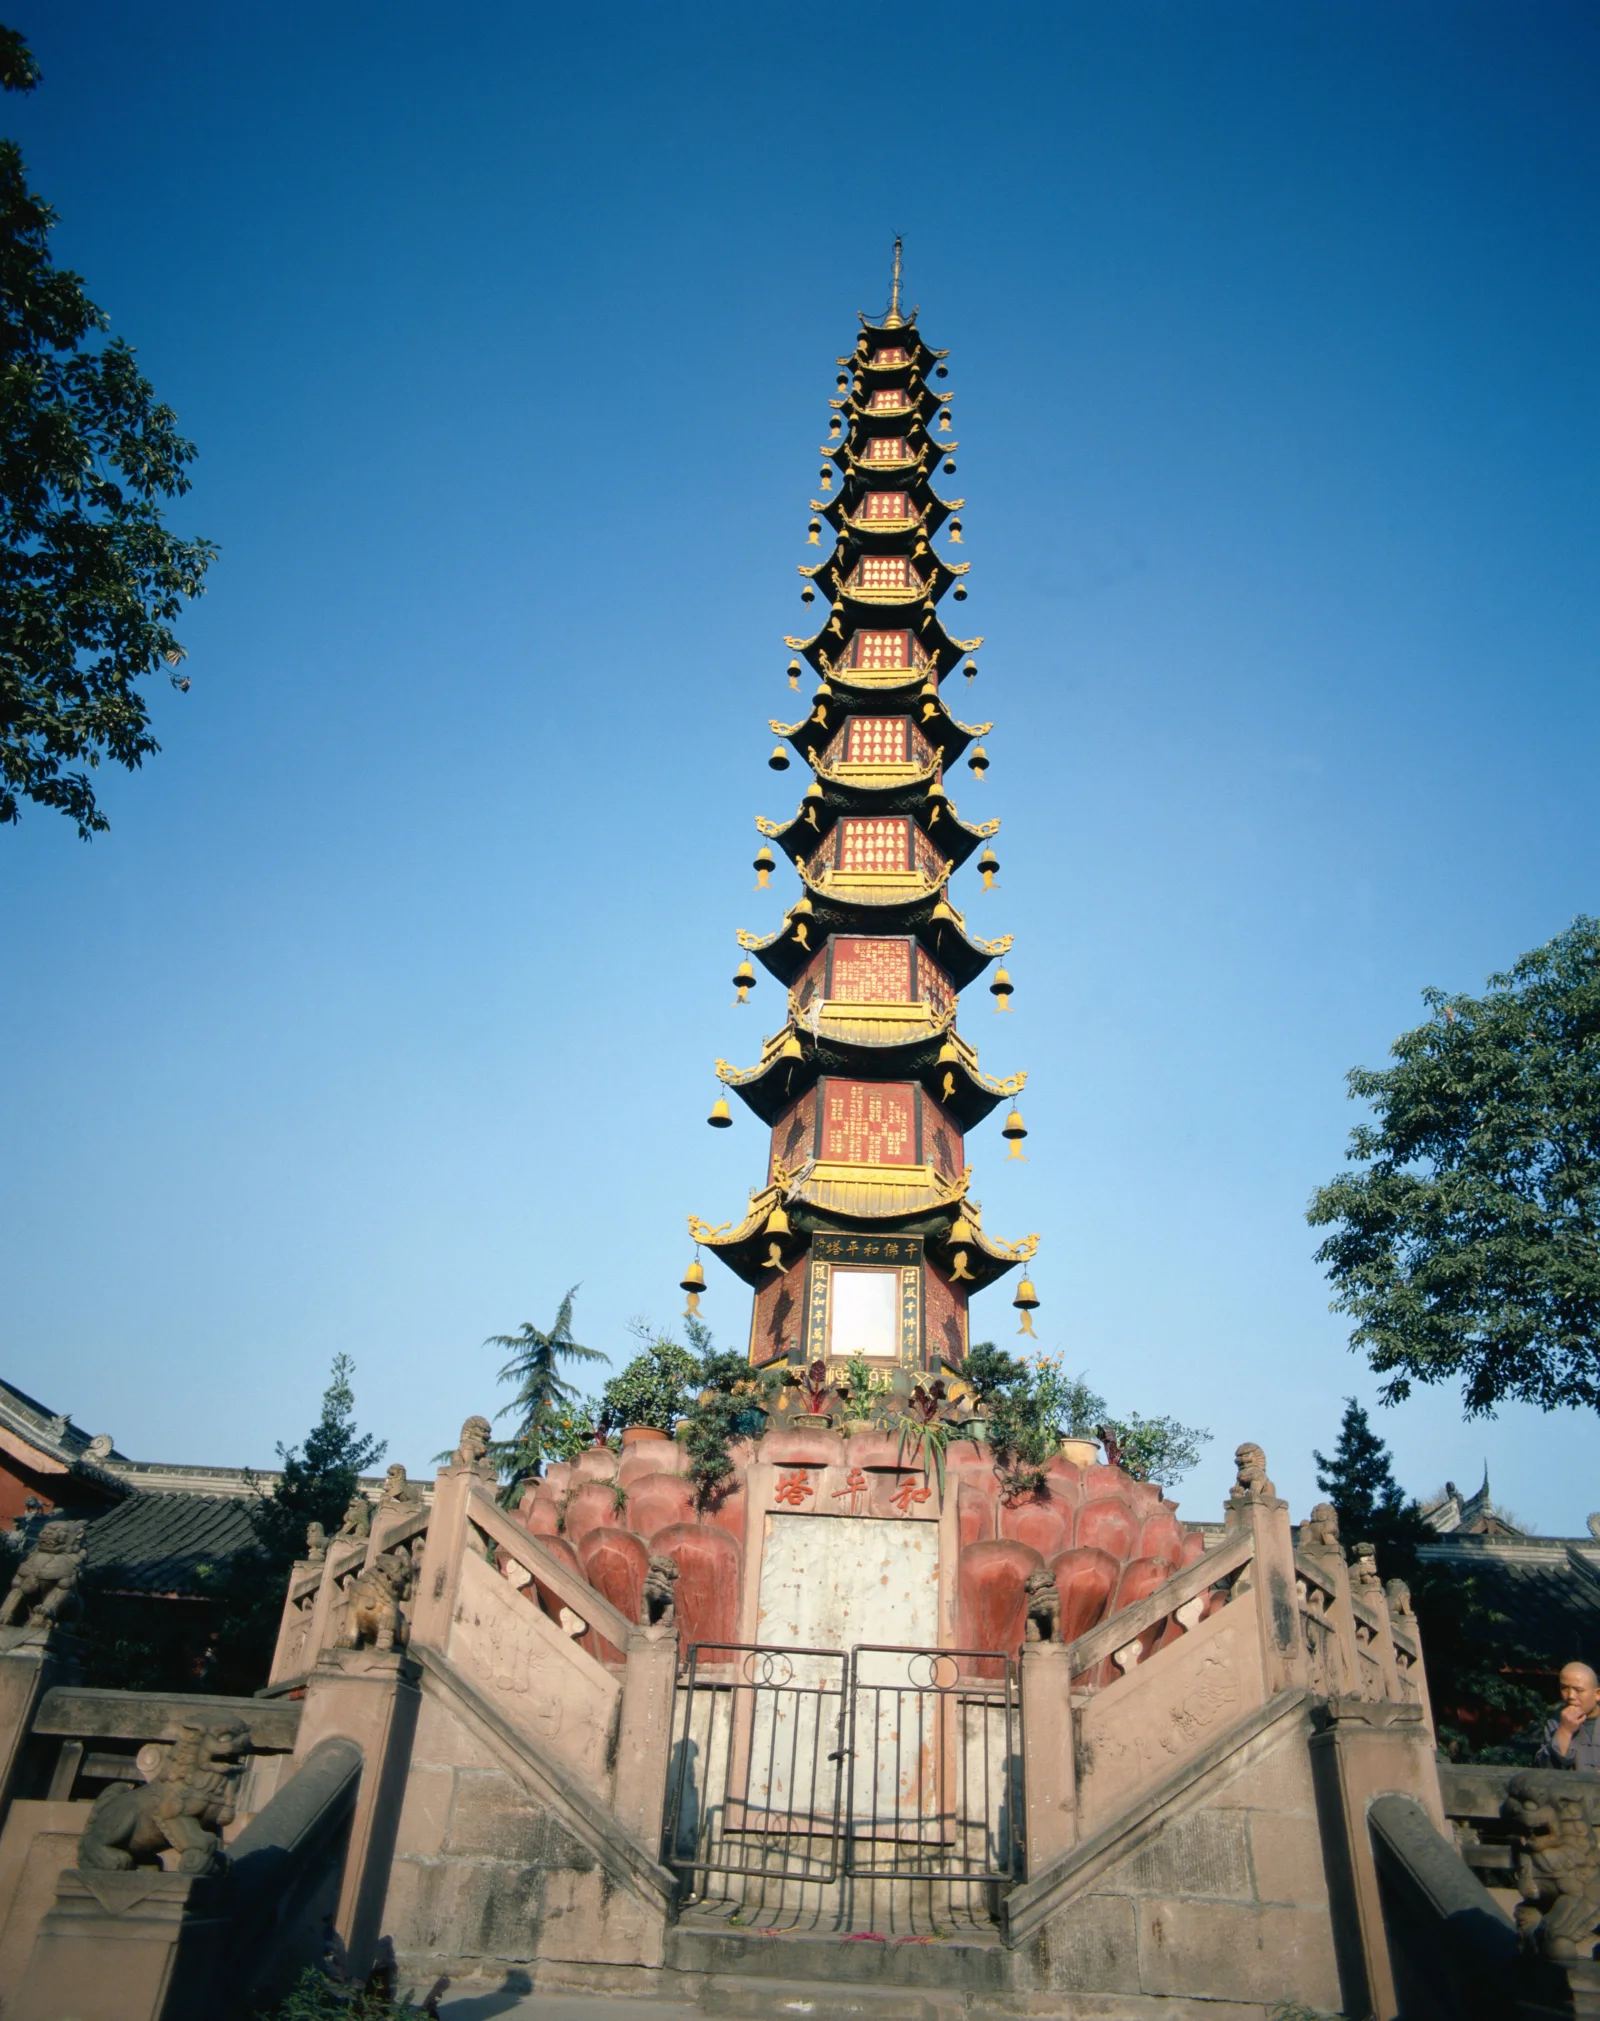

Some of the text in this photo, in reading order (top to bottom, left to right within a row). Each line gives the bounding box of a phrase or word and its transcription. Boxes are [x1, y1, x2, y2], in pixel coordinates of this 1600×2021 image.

[826, 1240, 918, 1260] 千佛和平塔
[775, 1468, 932, 1516] 和平塔
